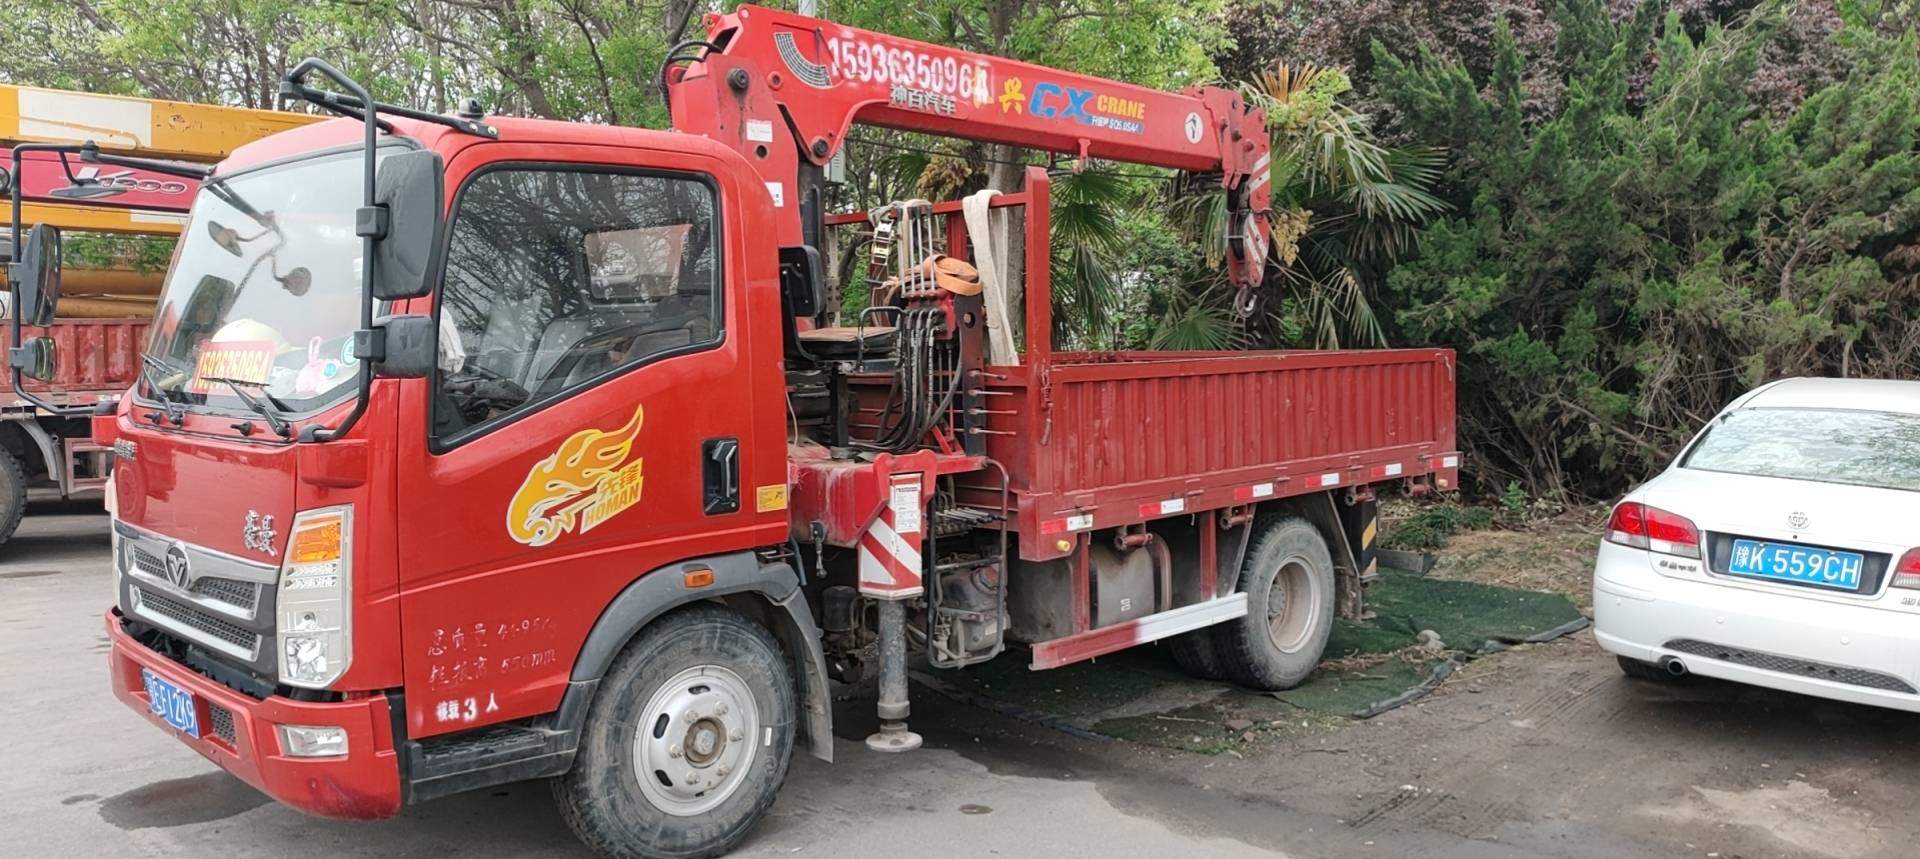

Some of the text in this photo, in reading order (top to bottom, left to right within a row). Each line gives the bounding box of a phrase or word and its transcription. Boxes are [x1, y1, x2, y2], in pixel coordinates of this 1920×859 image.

[1028, 82, 1094, 119] CX
[1096, 94, 1146, 120] CRANE
[583, 481, 641, 528] HOMAN
[463, 697, 478, 722] 3
[485, 691, 499, 714] 人
